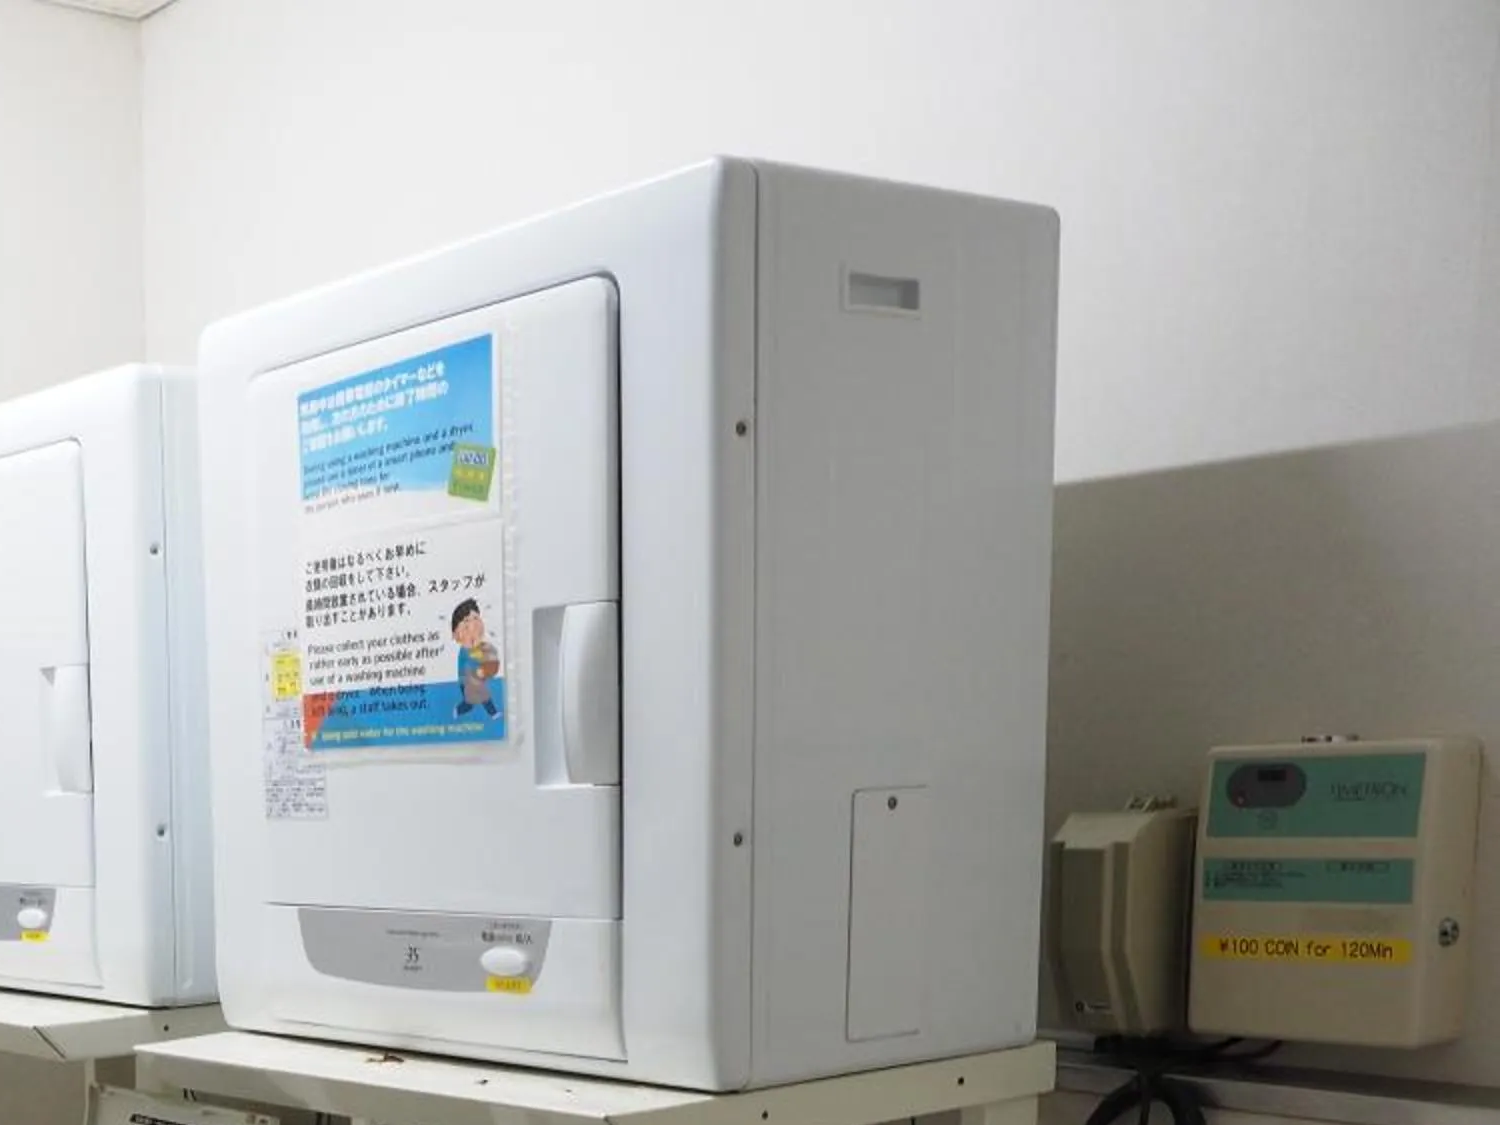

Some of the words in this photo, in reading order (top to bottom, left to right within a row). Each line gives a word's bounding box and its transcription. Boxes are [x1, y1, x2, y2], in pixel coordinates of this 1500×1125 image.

[366, 637, 386, 650] your
[389, 631, 424, 645] clothes
[427, 630, 439, 640] as
[374, 648, 412, 663] possible
[345, 668, 382, 683] washing
[1219, 937, 1259, 955] ¥100
[1265, 938, 1300, 957] COIN
[1307, 940, 1332, 958] for
